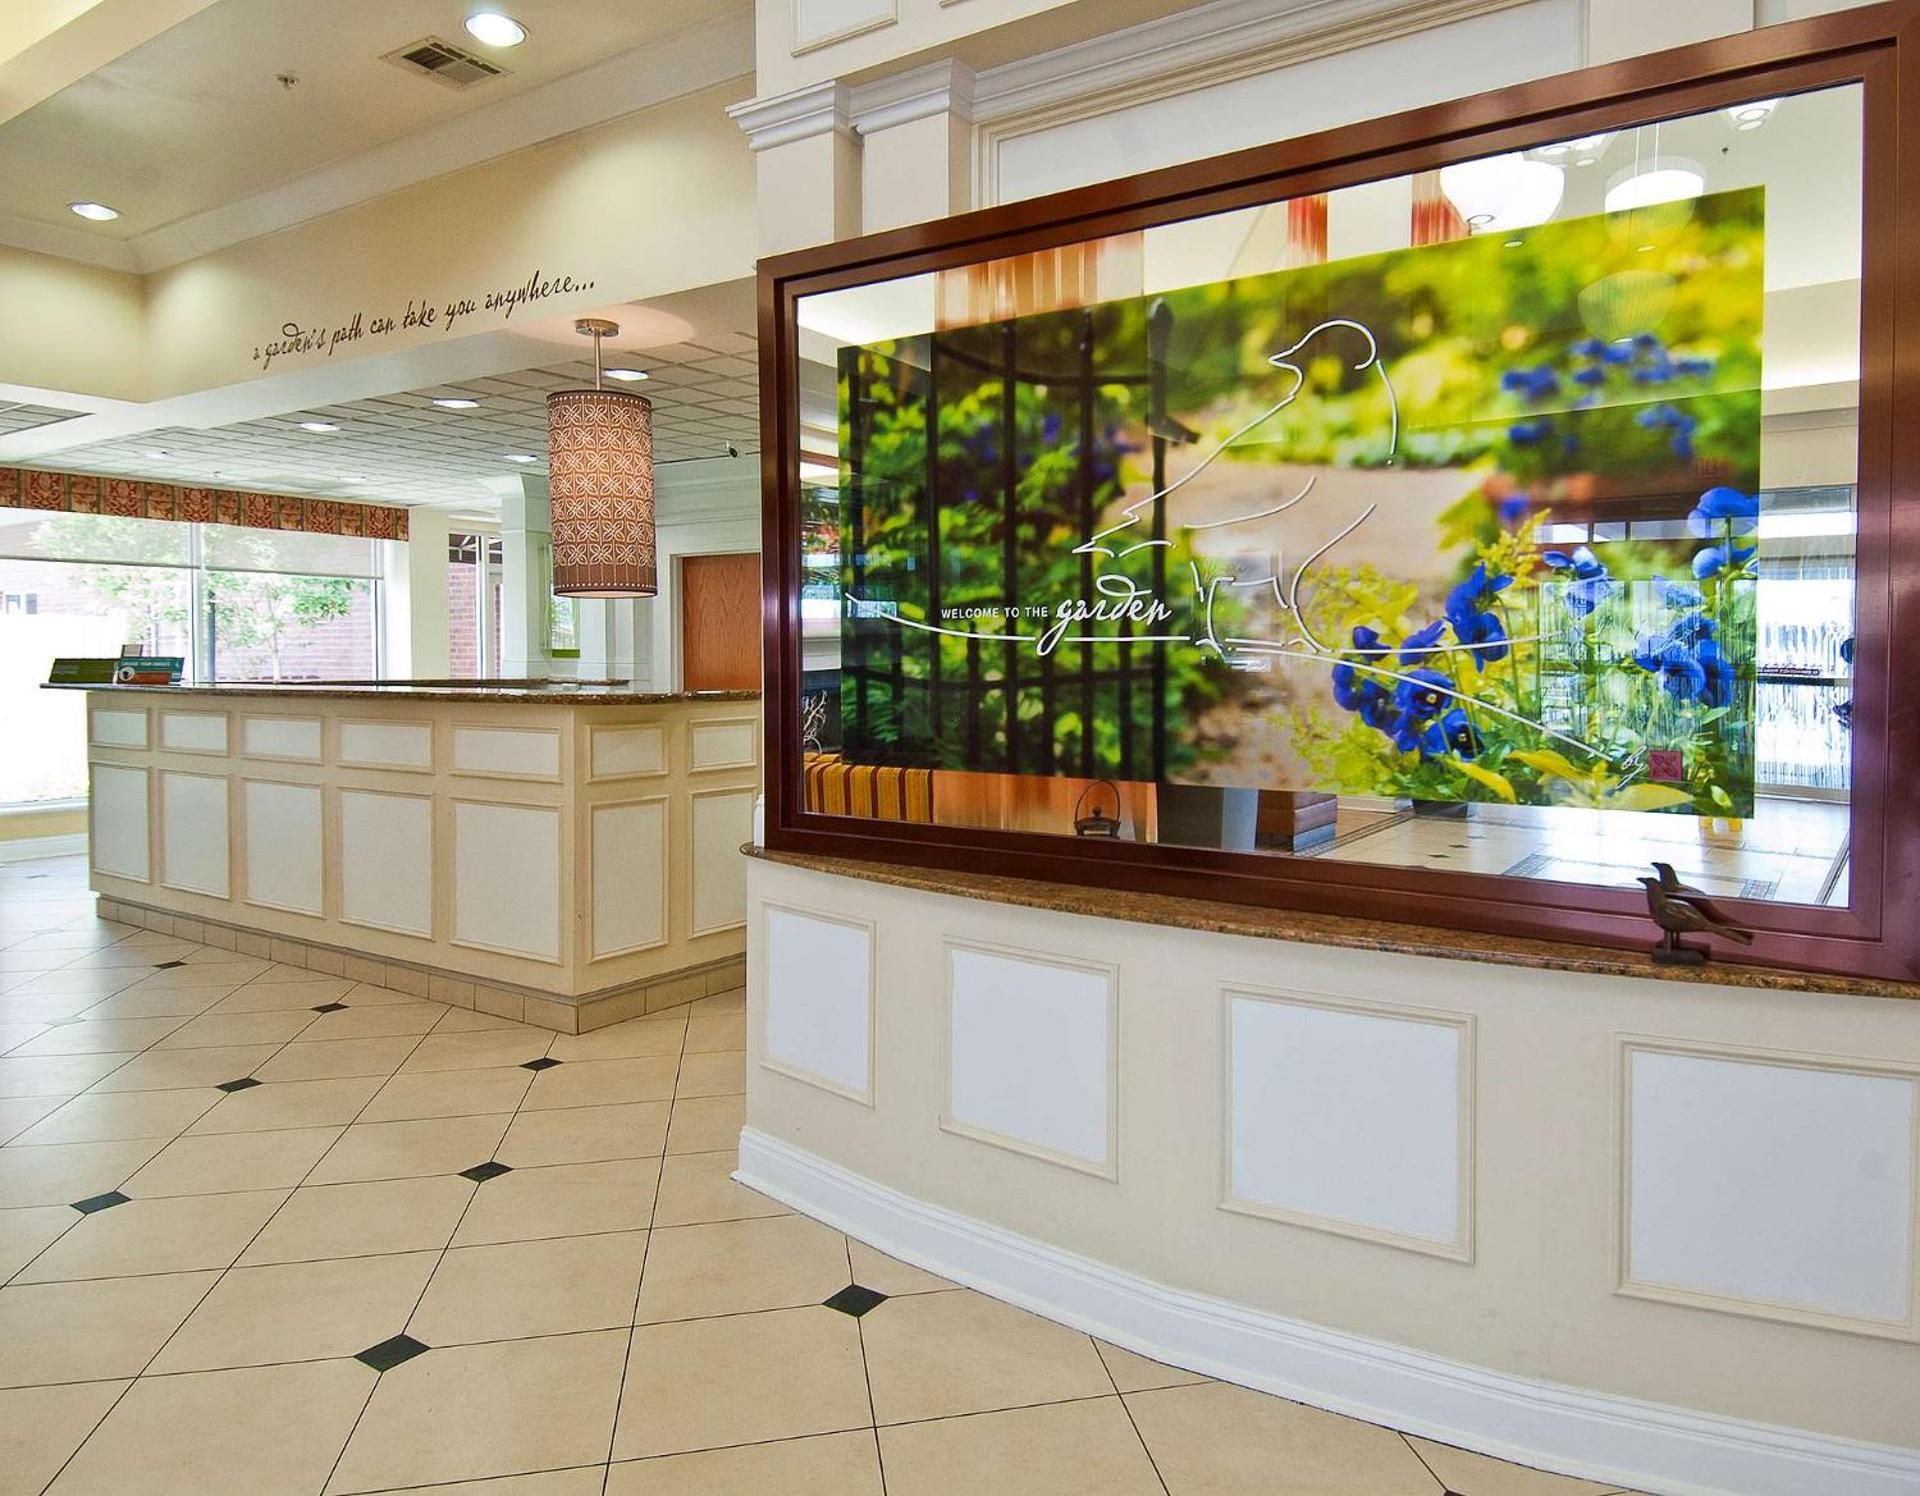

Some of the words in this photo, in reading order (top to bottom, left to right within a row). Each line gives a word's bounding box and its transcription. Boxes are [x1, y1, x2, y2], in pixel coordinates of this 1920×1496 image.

[263, 322, 326, 370] garden's
[329, 312, 364, 356] path
[369, 318, 397, 334] can
[402, 301, 437, 330] take
[444, 302, 477, 332] you
[484, 270, 595, 319] anywhere...
[941, 607, 999, 619] WELCOME
[1004, 606, 1020, 618] TO
[1024, 606, 1049, 618] THE
[1037, 574, 1173, 656] garden
